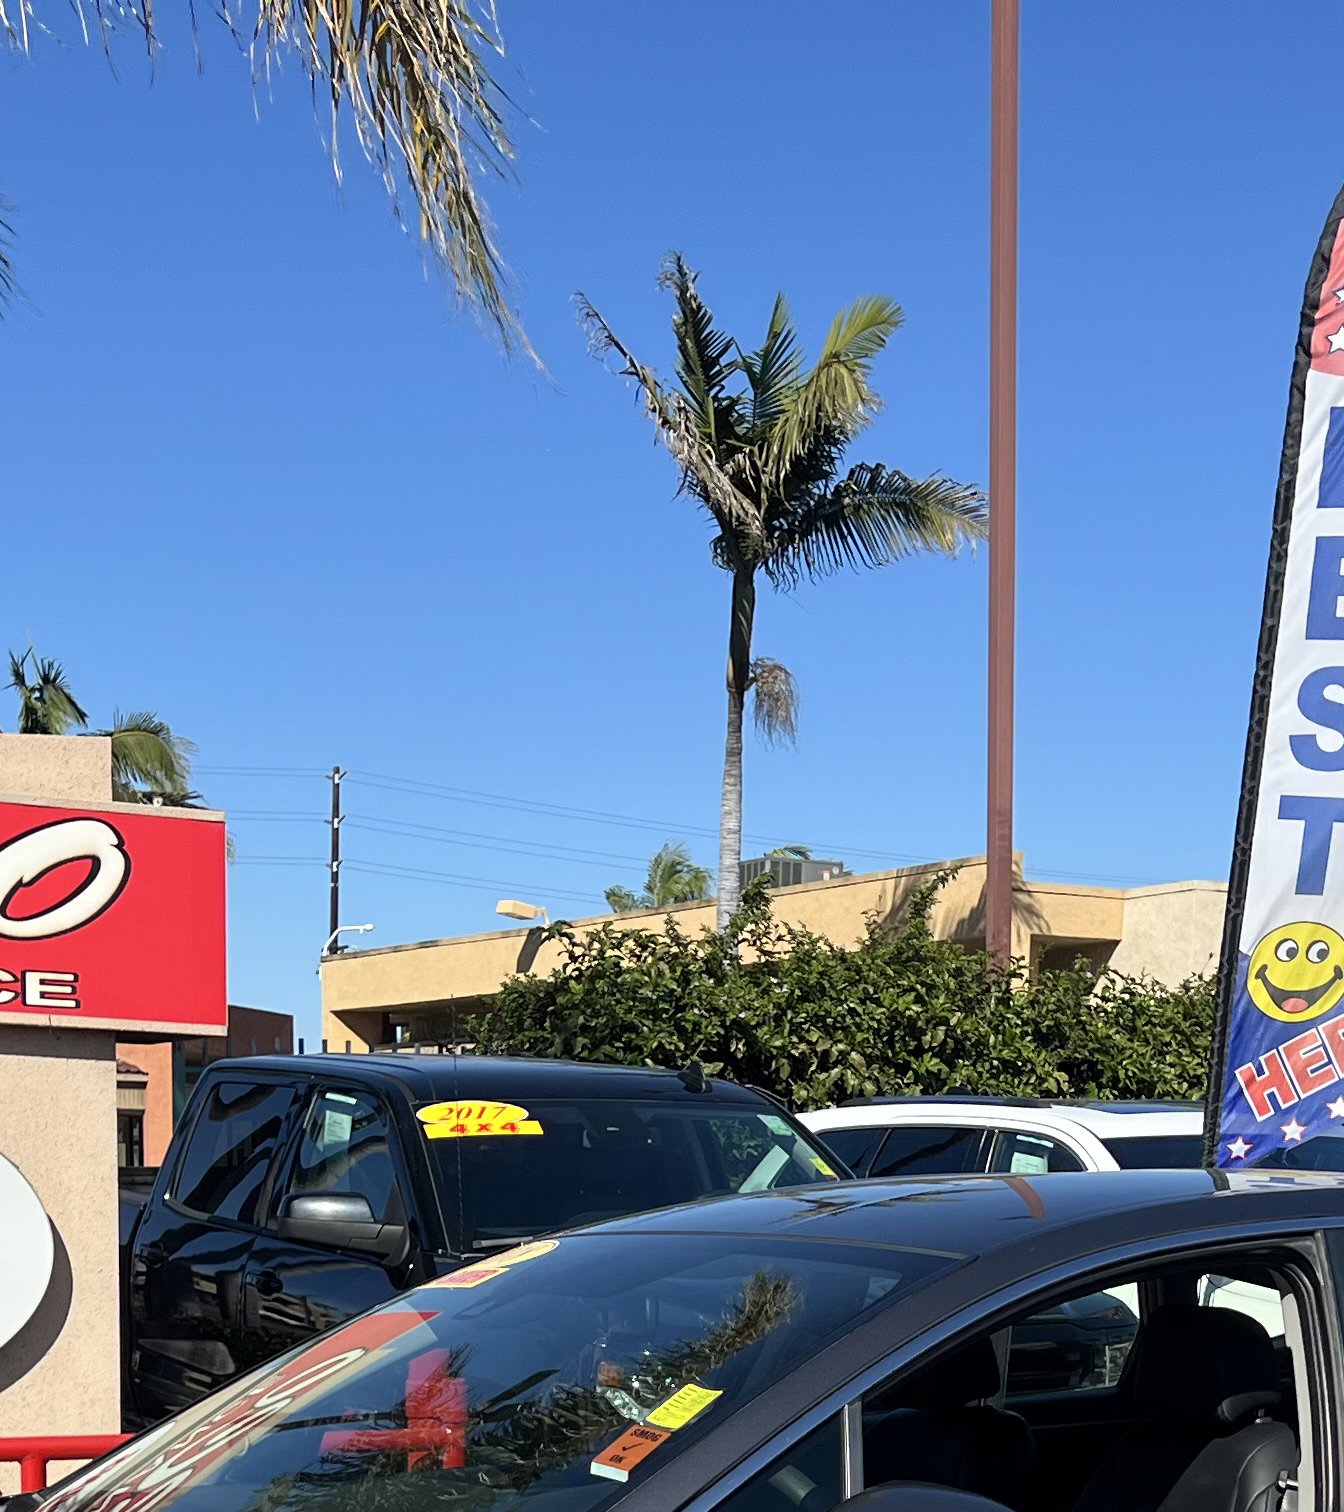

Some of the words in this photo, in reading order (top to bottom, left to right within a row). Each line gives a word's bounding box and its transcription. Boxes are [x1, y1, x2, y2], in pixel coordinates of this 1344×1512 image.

[437, 1105, 507, 1121] 2017
[629, 1428, 663, 1443] SMOG
[608, 1453, 626, 1465] OK
